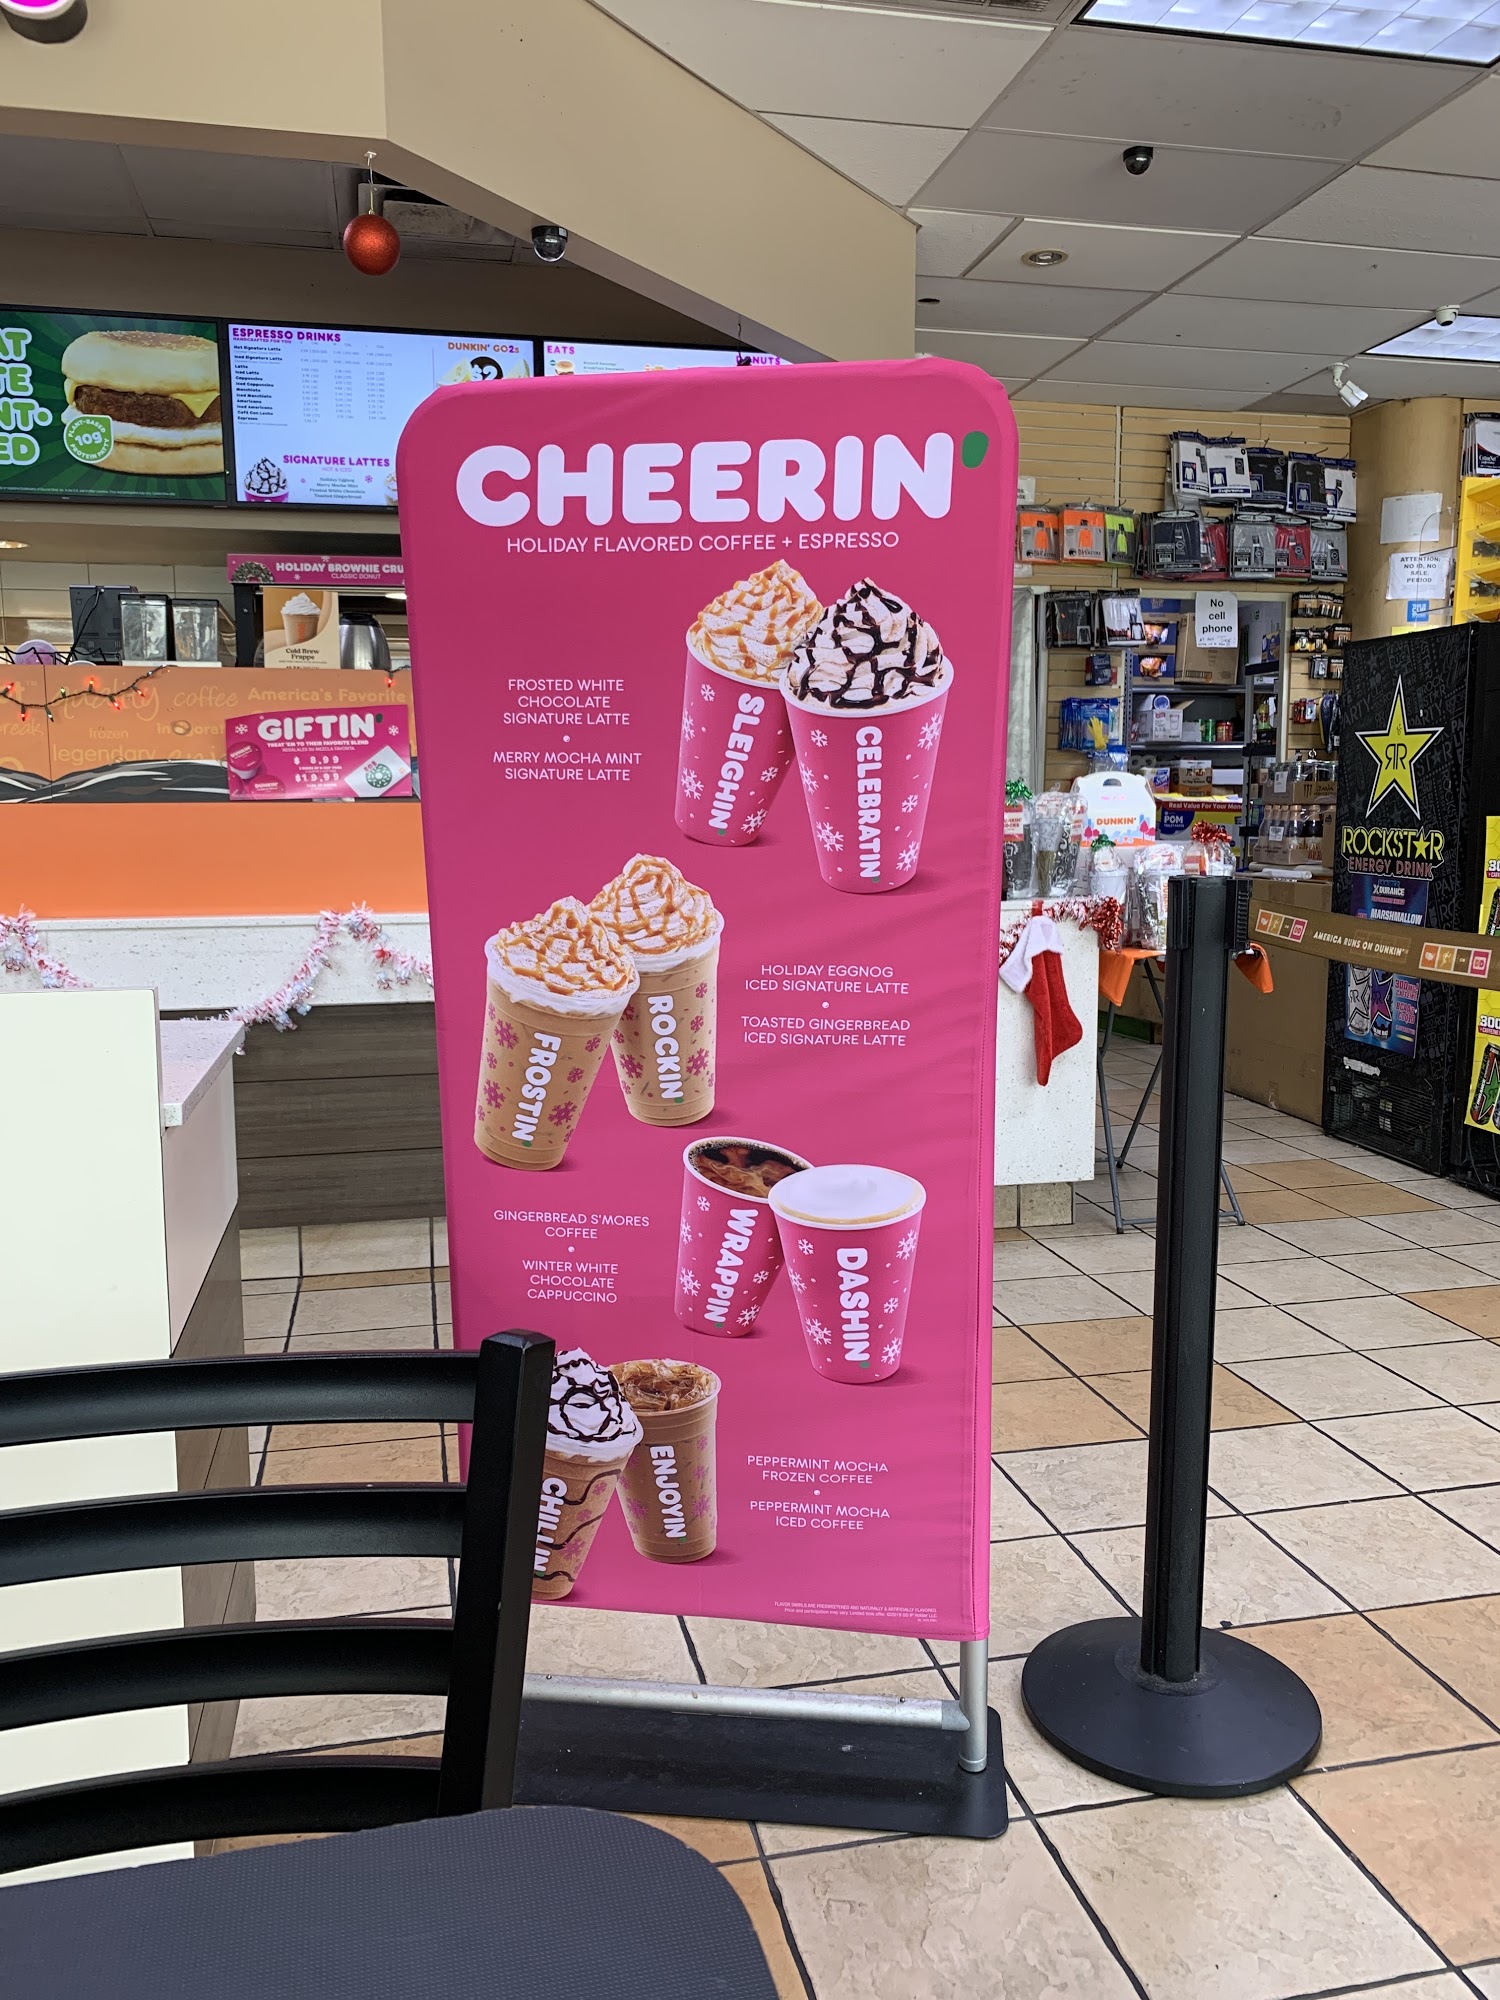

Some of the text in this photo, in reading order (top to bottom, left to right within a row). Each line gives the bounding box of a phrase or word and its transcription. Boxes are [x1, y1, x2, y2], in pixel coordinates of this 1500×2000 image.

[232, 327, 341, 342] ESPRESSO DRINKS
[448, 342, 490, 351] DUNKIN'
[547, 345, 575, 355] EATS
[736, 356, 780, 365] DNUTS
[68, 419, 106, 438] PLANT-BASED
[75, 431, 103, 446] 10g
[70, 443, 98, 459] PROTEIN
[283, 455, 390, 467] SIGNATURE LATTES
[506, 531, 900, 553] HOLIDAY FLAVORED COFFEE + ESPRESSO
[276, 562, 327, 573] HOLIDAY
[328, 563, 380, 574] BROWNIE
[1210, 598, 1224, 608] No
[1208, 611, 1226, 621] cell
[1202, 624, 1233, 635] phone
[508, 679, 624, 692] FROSTED WHITE
[173, 685, 238, 707] coffee
[248, 688, 407, 702] America's Favorite
[518, 696, 611, 708] CHOCOLATE
[503, 712, 630, 725] SIGNATURE LATTE
[89, 727, 129, 740] frozen
[52, 744, 156, 766] legendary
[493, 751, 642, 765] MERRY MOCHA MINT
[505, 768, 631, 781] SIGNATURE LATTE
[1168, 802, 1183, 810] Real
[1183, 802, 1201, 810] Value
[1201, 802, 1212, 810] For
[1096, 817, 1137, 825] DUNKIN'
[1164, 815, 1184, 825] POM
[1349, 857, 1433, 877] ENERGY DRINK
[1370, 909, 1422, 925] MARSHMALLOW
[1313, 931, 1342, 945] AMERICA
[1343, 937, 1360, 950] RUNS
[1362, 941, 1373, 952] ON
[761, 964, 894, 978] HOLIDAY EGGNOG
[745, 979, 909, 994] ICED SIGNATURE LATTE
[741, 1016, 911, 1031] TOASTED GINGERBREAD
[744, 1032, 906, 1047] ICED SIGNATURE LATTE
[493, 1210, 650, 1227] GINGERBREAD S'MORES
[545, 1227, 598, 1239] COFFEE
[522, 1260, 618, 1274] WINTER WHITE
[530, 1274, 615, 1289] CHOCOLATE
[527, 1288, 617, 1303] CAPPUCCINO
[747, 1455, 889, 1473] PEPPERMINT MOCHA
[762, 1470, 873, 1485] FROZEN COFFEE
[750, 1501, 891, 1519] PEPPERMINT MOCHA
[776, 1516, 864, 1530] ICED COFFEE
